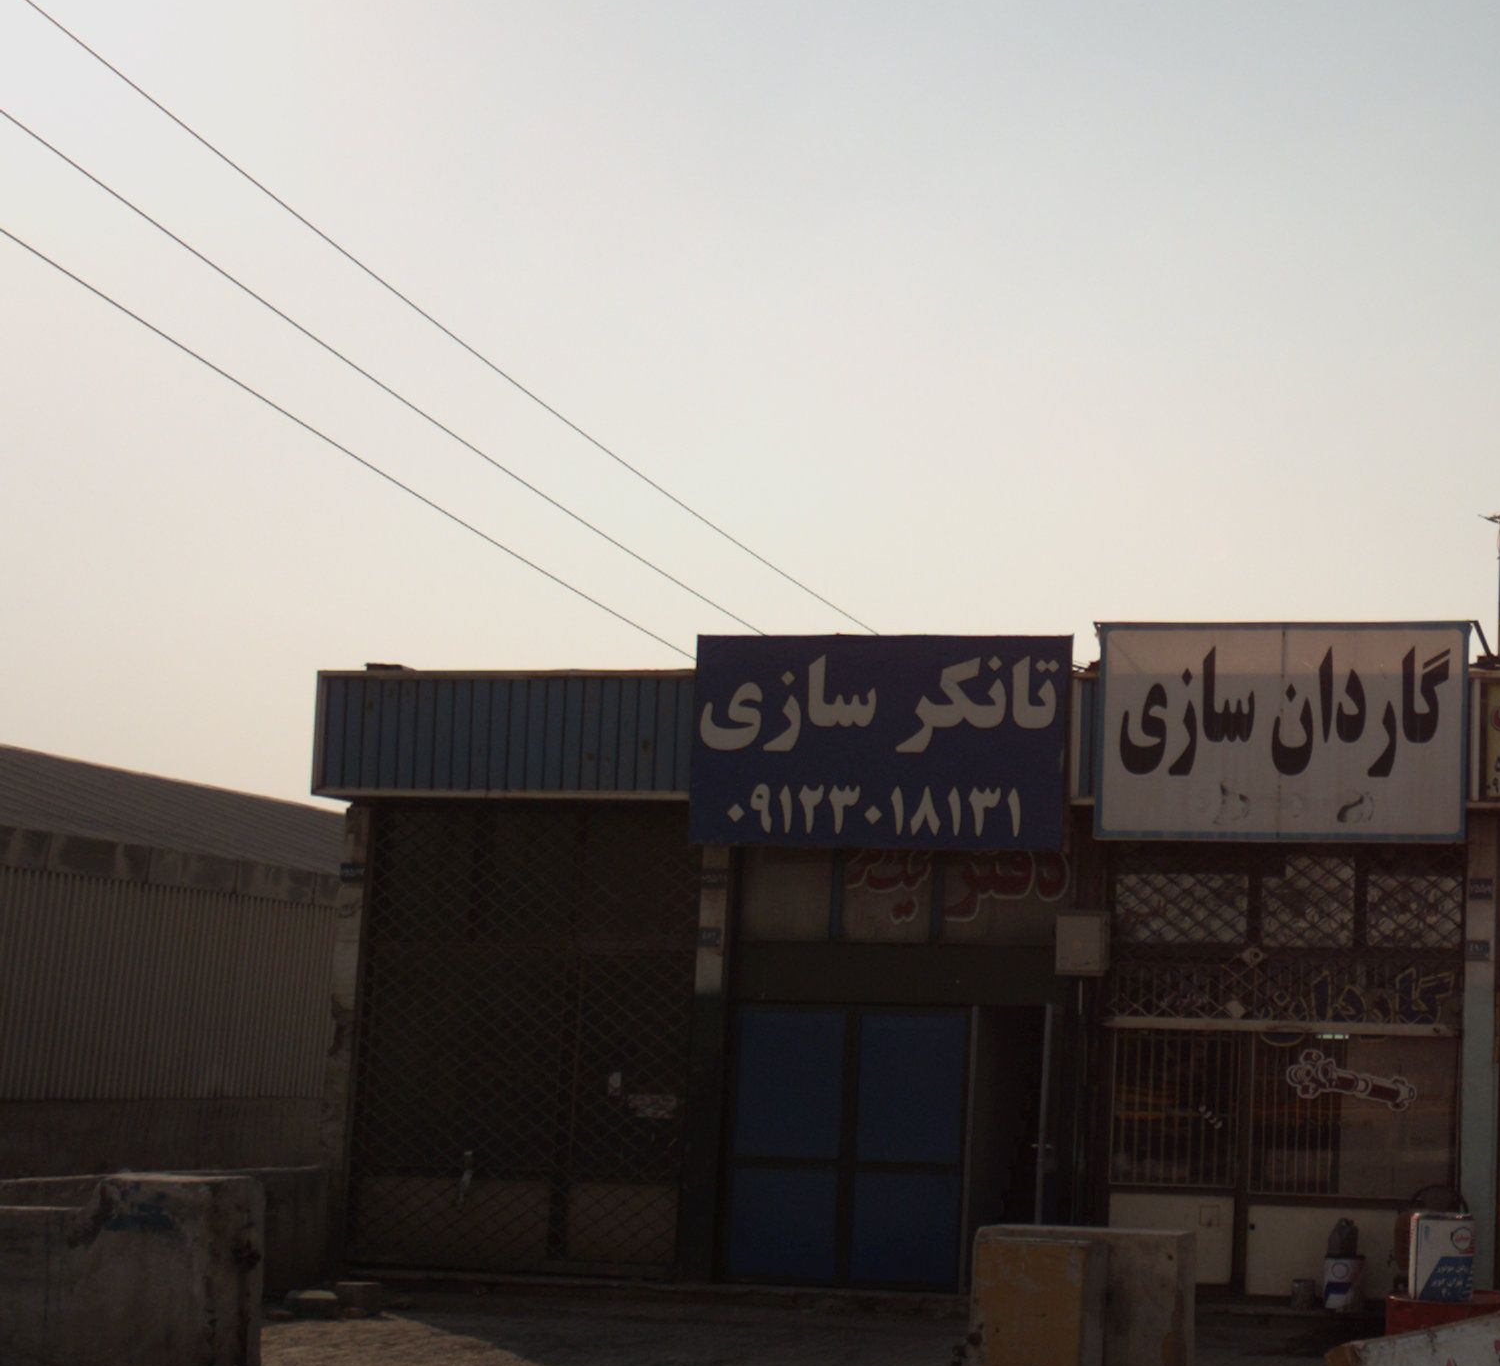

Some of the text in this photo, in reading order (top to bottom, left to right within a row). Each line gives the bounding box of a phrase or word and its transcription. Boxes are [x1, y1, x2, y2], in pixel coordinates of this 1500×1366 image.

[700, 654, 1060, 753] تانکر سازی
[1119, 645, 1451, 777] گاردان سازی
[727, 783, 1021, 838] ۰۹۱۲۳۰۱۸۱۳۱
